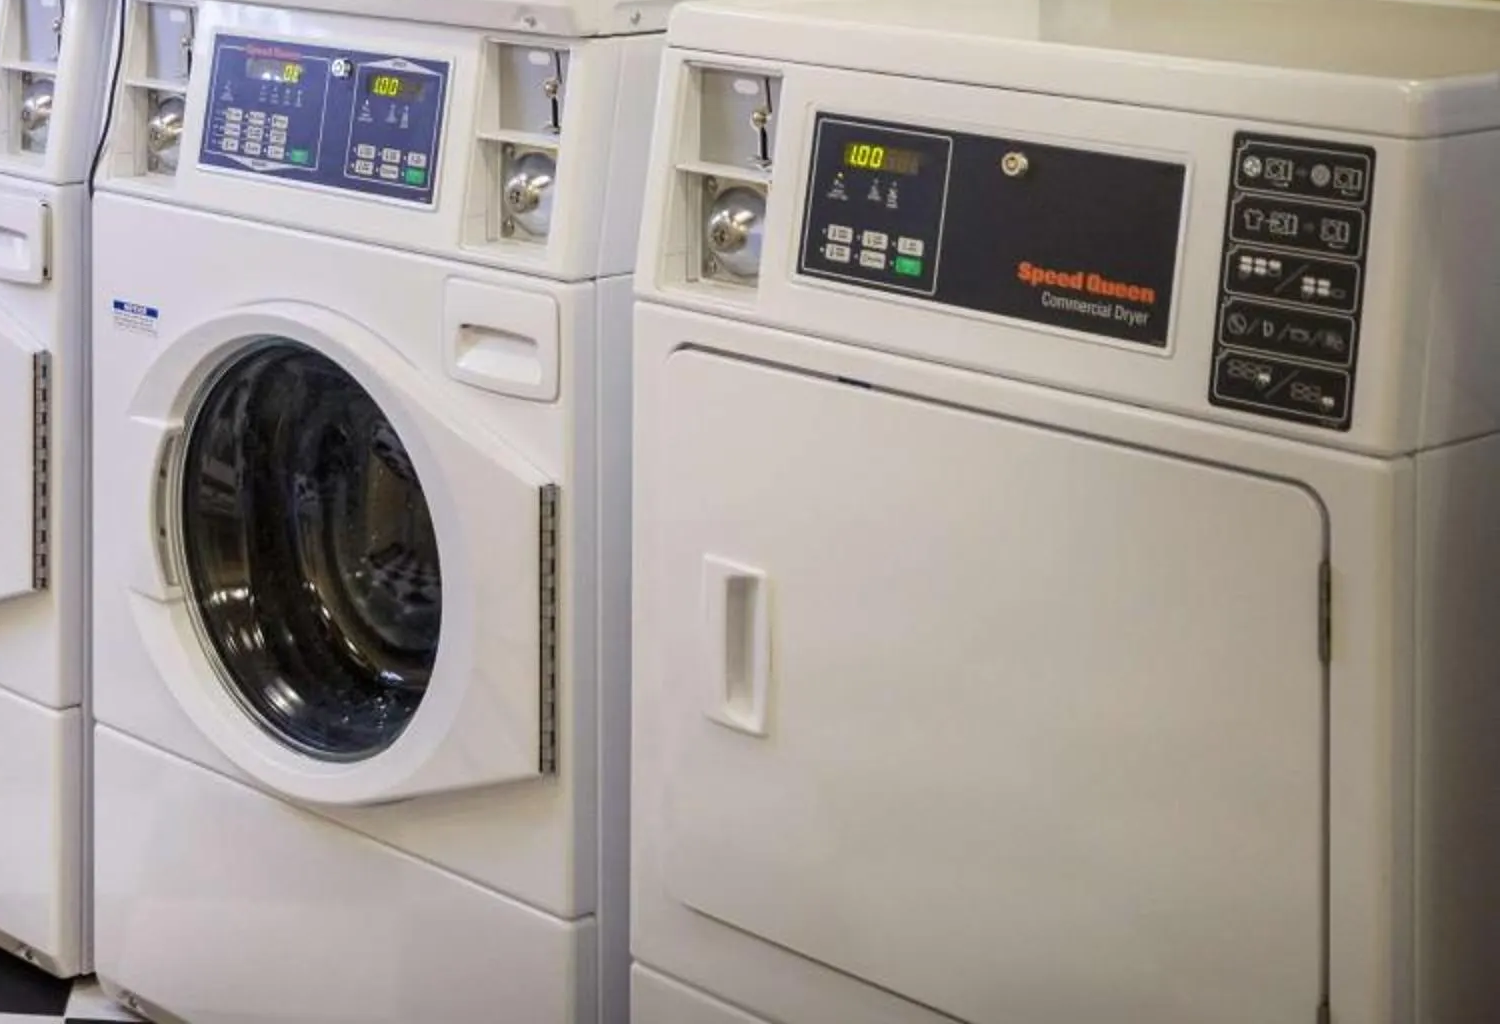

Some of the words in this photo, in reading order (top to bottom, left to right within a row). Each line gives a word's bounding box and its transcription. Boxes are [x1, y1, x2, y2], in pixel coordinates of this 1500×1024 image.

[1017, 261, 1084, 290] Speed
[1086, 273, 1156, 304] Queen
[1041, 290, 1113, 318] Commercial
[1114, 304, 1150, 326] Dryer
